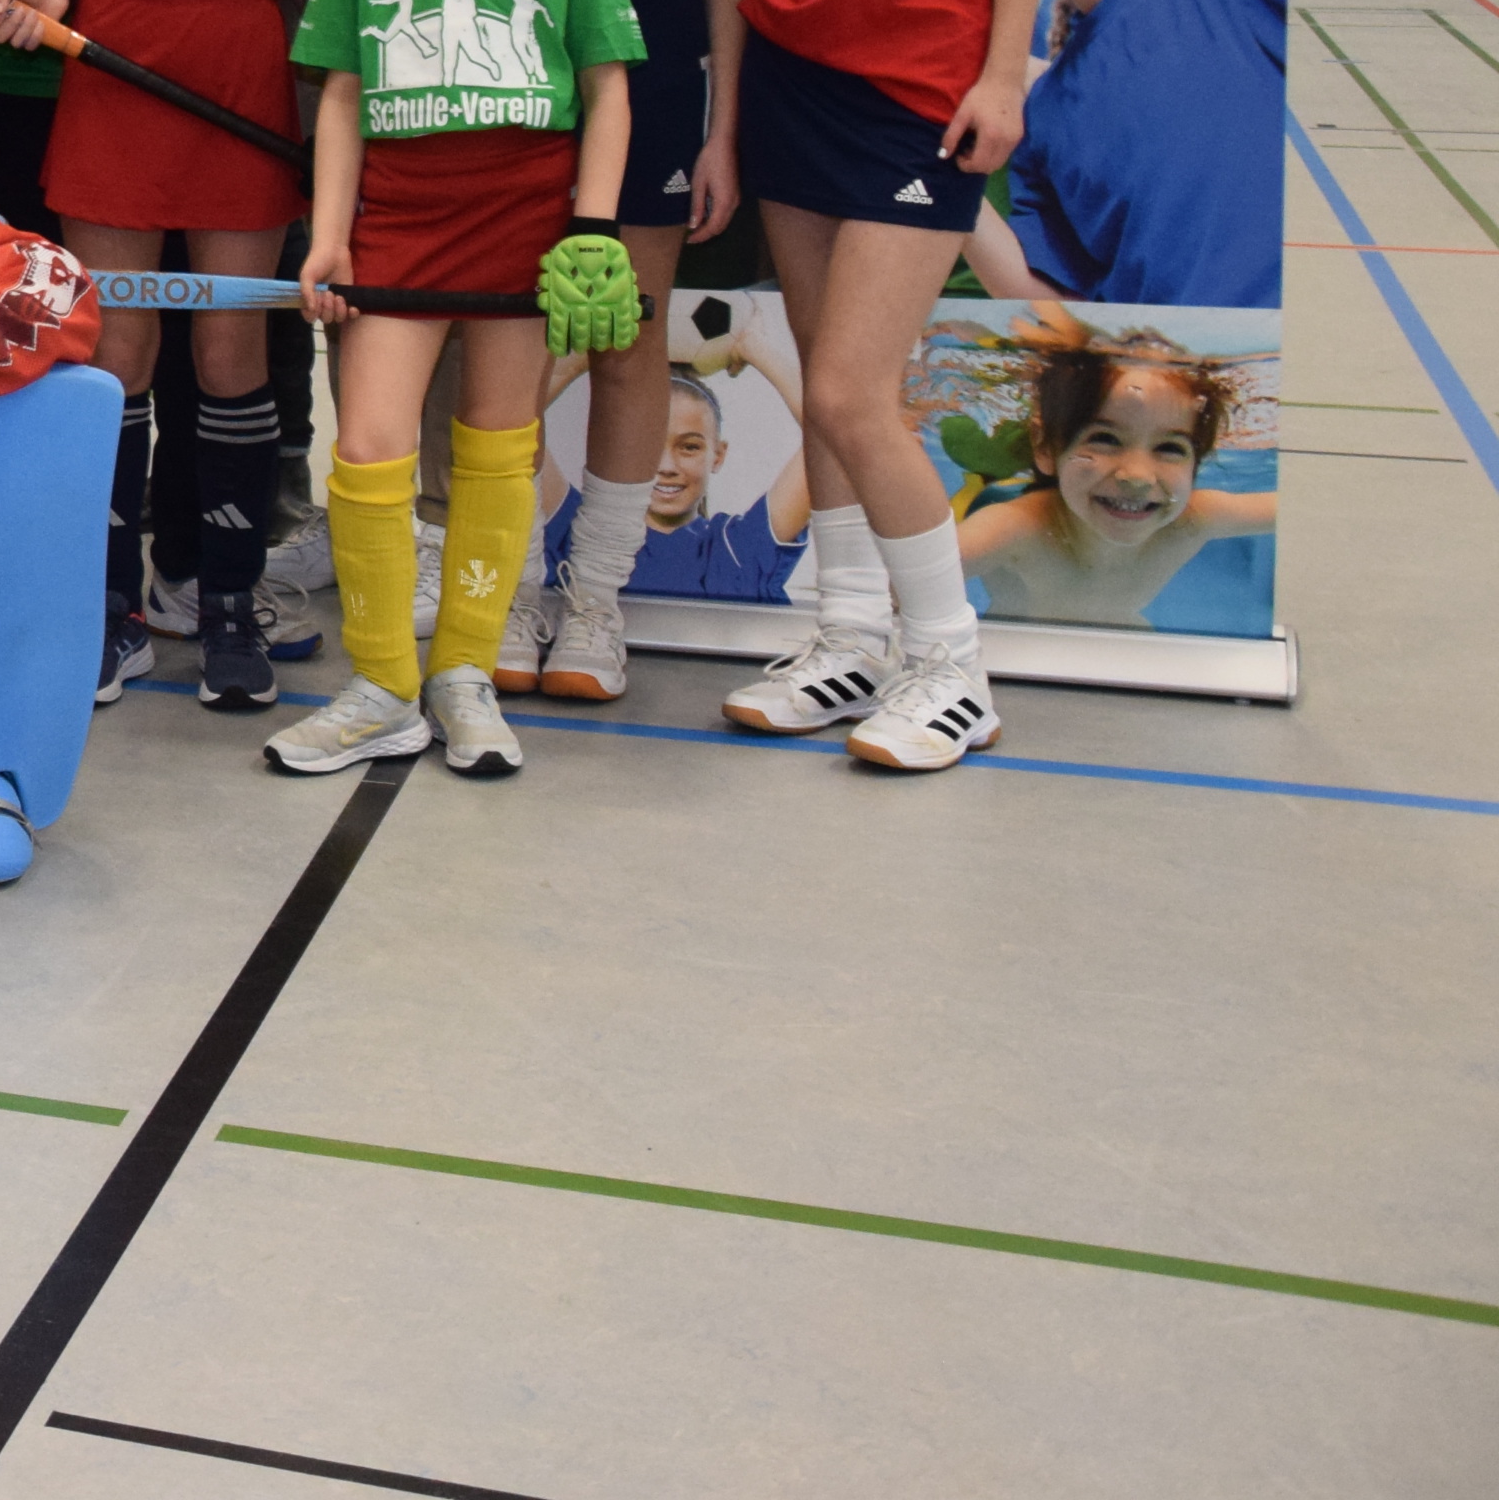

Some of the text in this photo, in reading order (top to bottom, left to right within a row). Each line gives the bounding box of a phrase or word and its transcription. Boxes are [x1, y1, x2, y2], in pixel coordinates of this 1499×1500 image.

[369, 90, 552, 133] Schule+Verein
[663, 184, 691, 194] adidas
[894, 192, 934, 205] adidas
